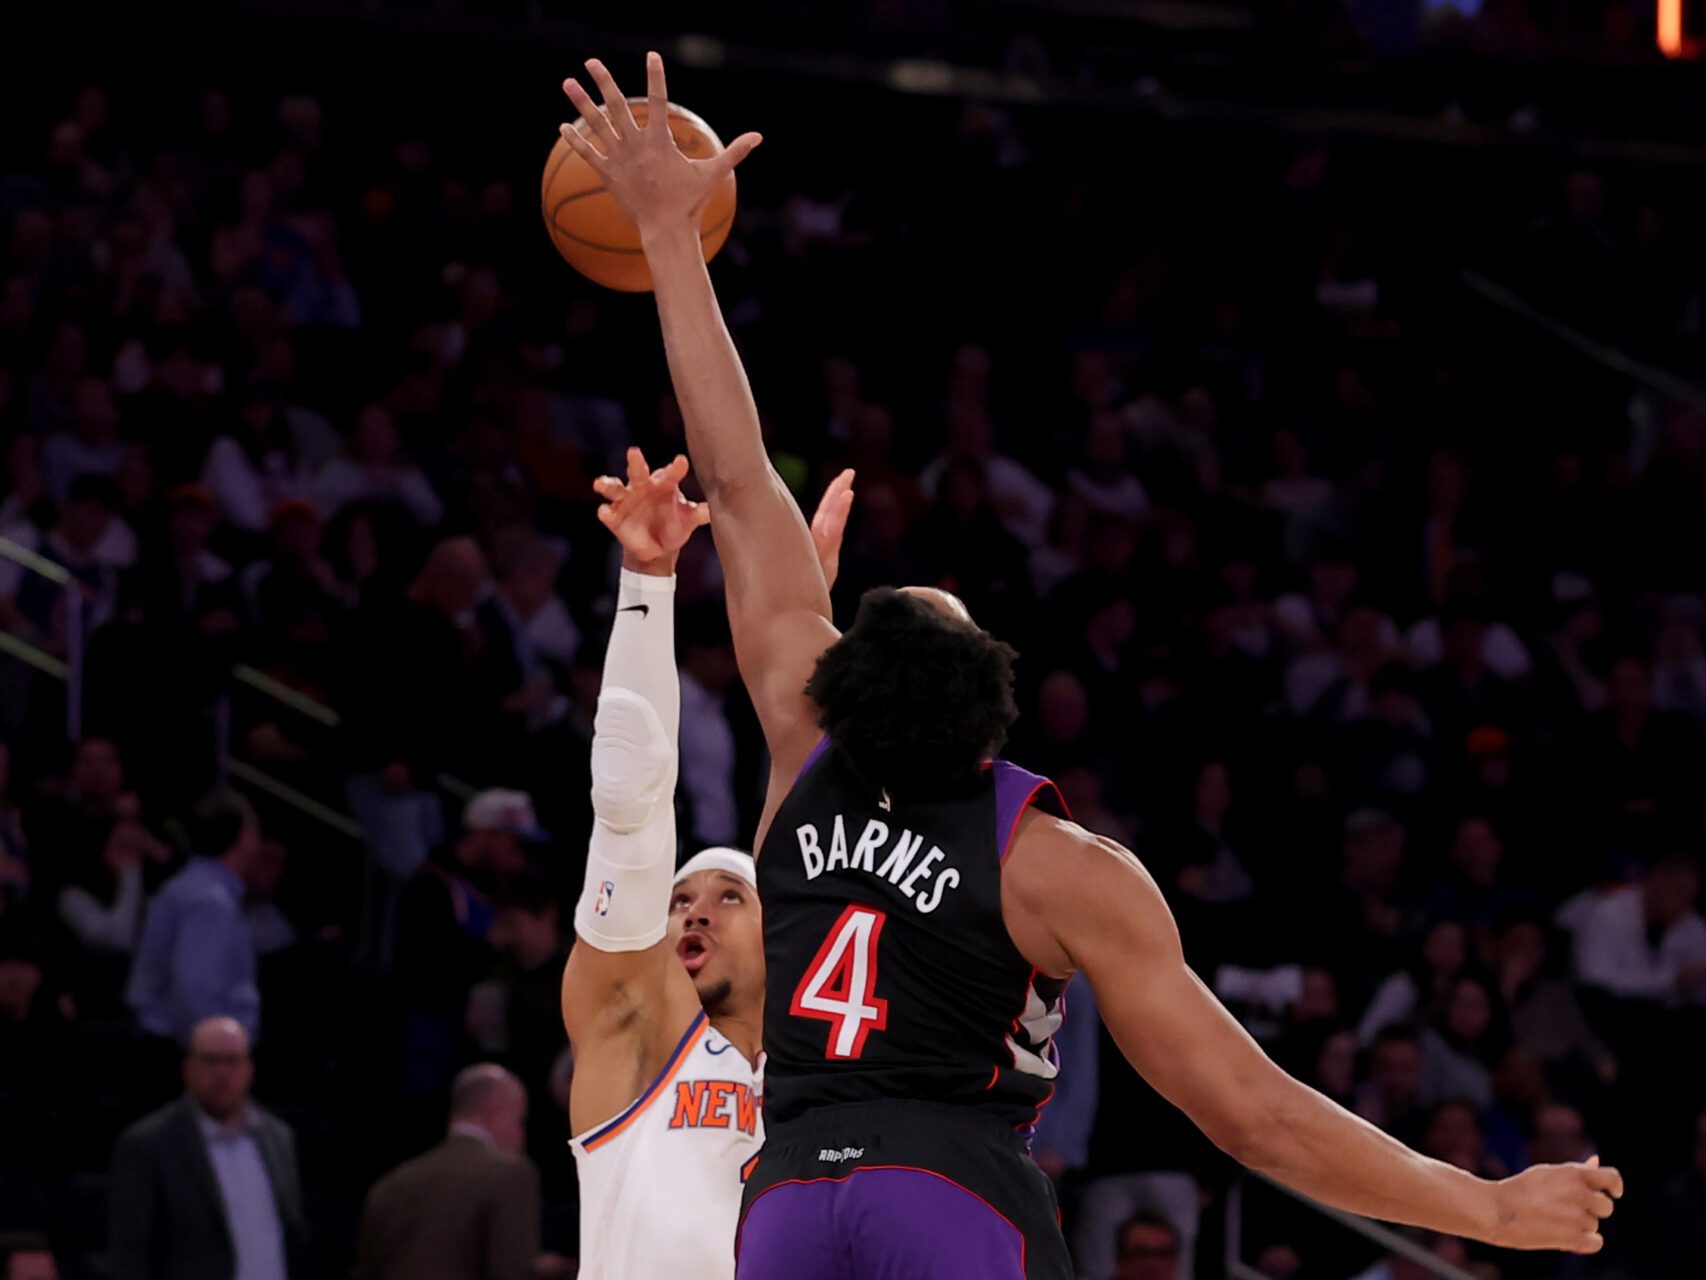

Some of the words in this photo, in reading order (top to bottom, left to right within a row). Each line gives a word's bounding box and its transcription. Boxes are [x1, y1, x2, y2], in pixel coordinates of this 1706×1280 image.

[796, 814, 960, 913] BARNES
[789, 900, 888, 1060] 4
[668, 1080, 758, 1137] NEW
